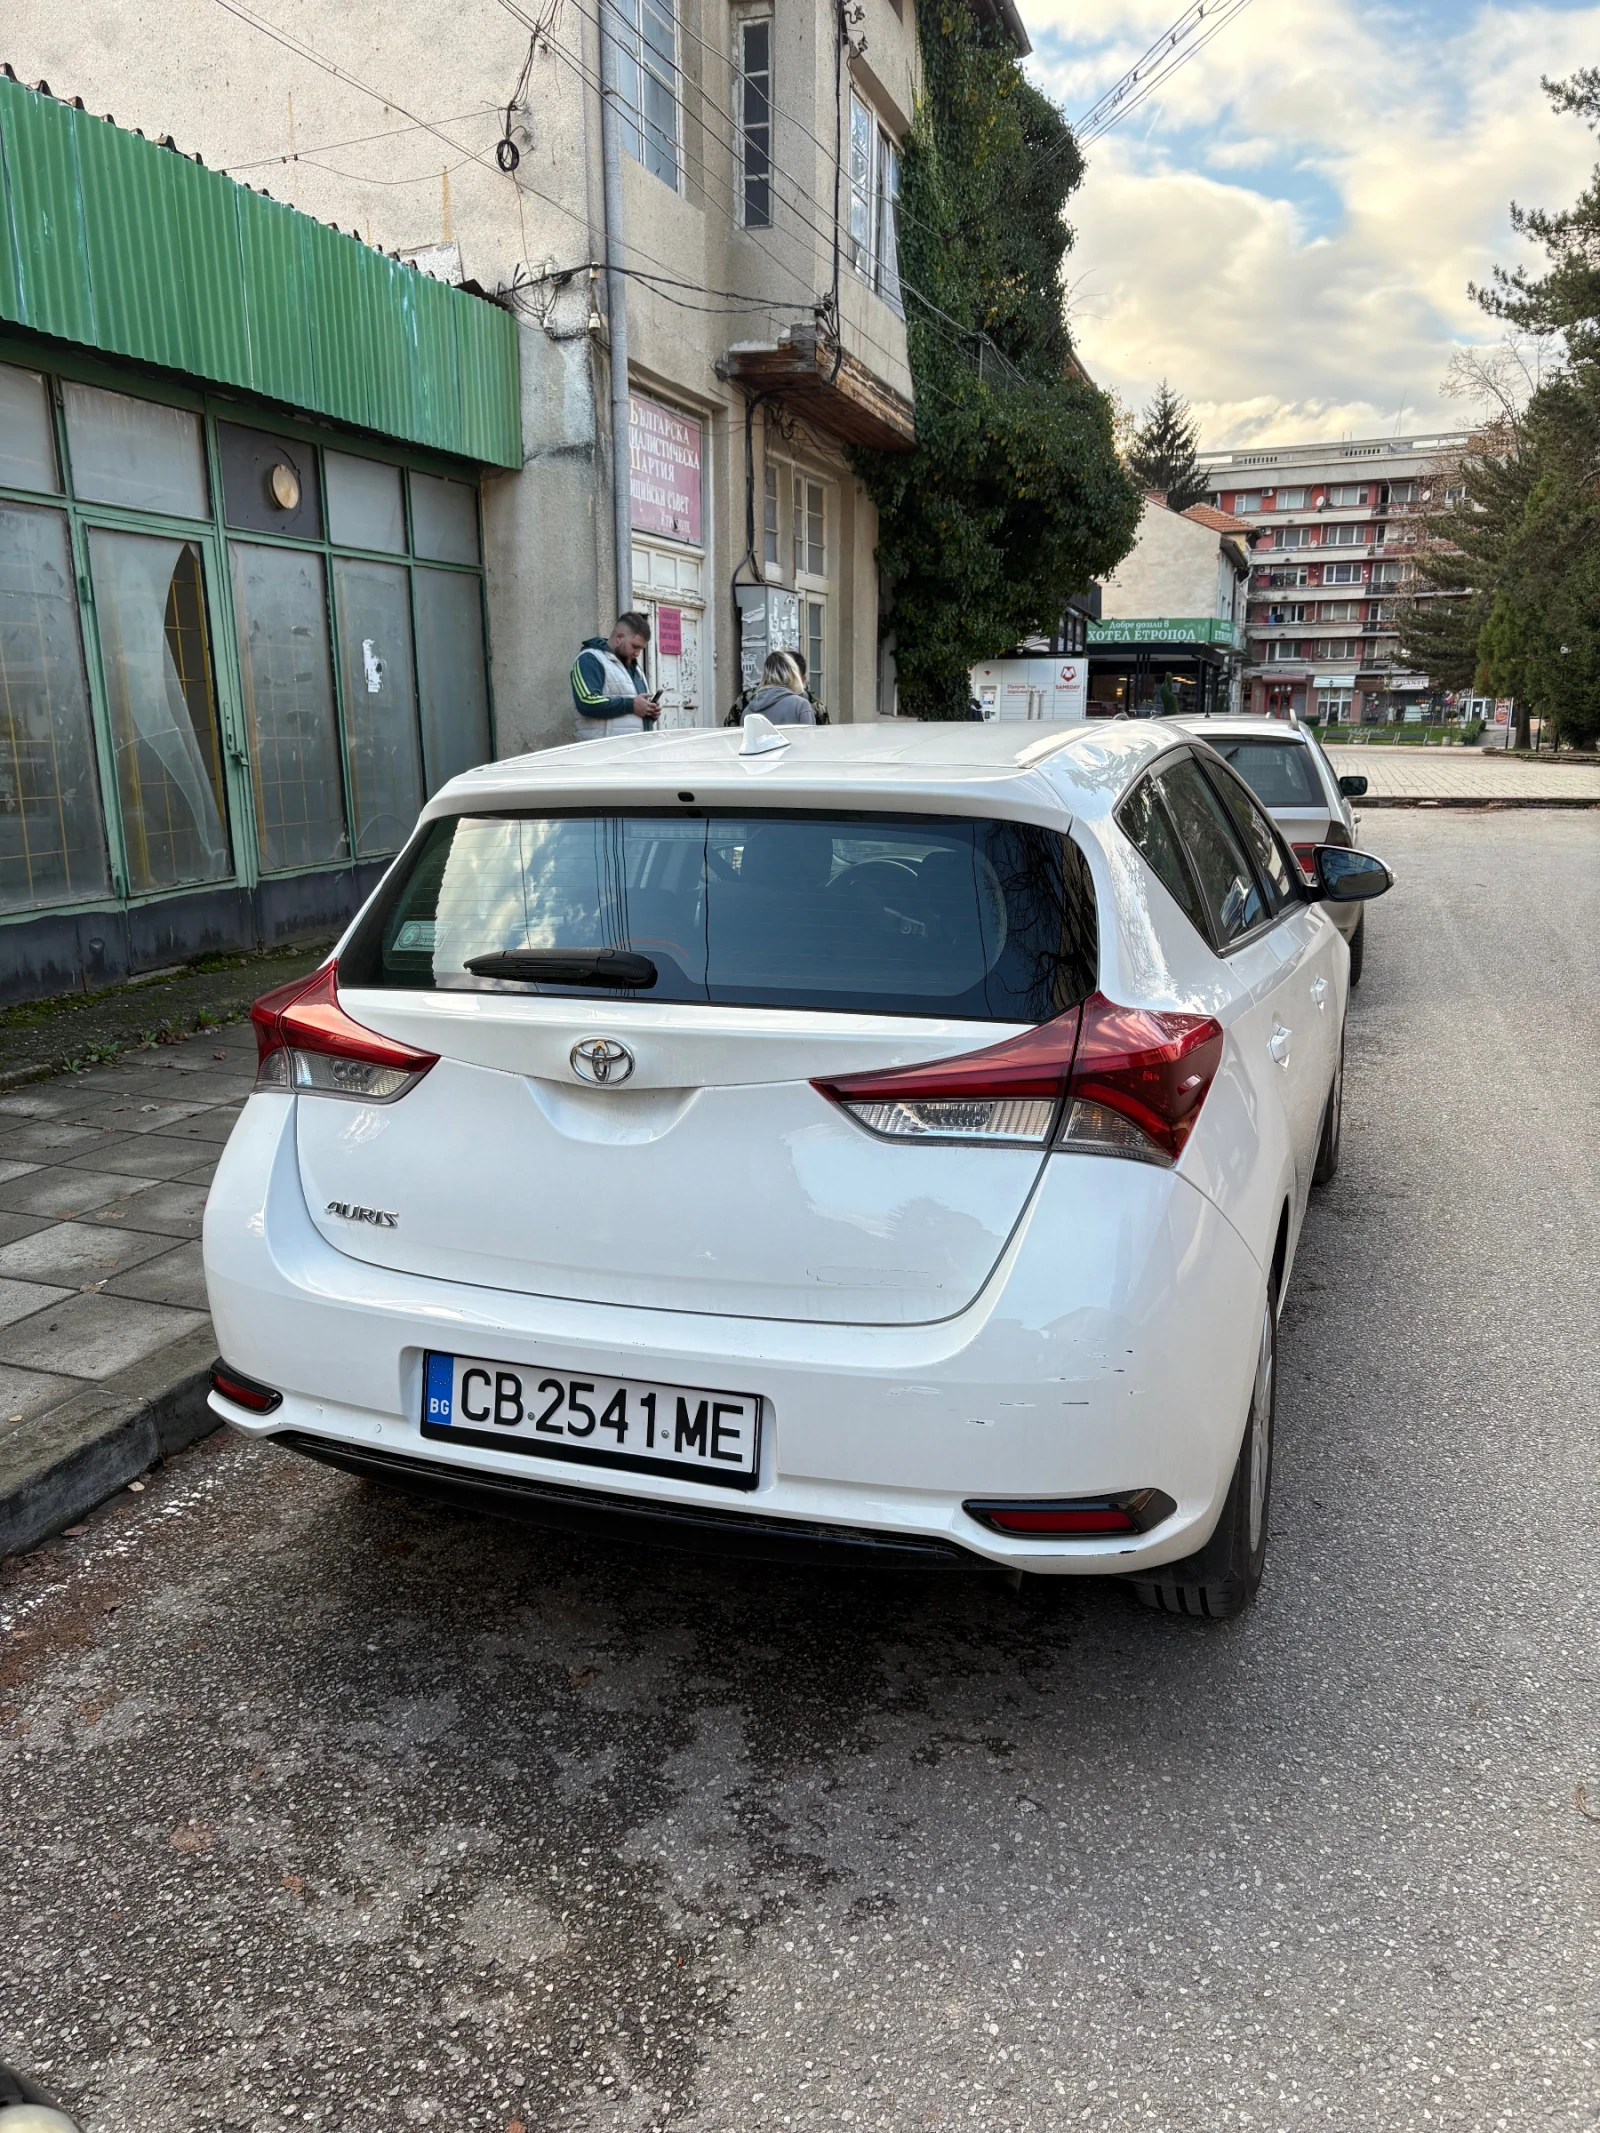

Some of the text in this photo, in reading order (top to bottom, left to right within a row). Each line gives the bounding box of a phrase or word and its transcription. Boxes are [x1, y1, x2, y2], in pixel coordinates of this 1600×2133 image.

[629, 399, 690, 445] БЪЛГАРСКА
[630, 446, 675, 482] ПАРТИЯ
[1087, 630, 1196, 641] ХОТЕЛ ЕТРОПОЛ
[1109, 621, 1134, 630] Добре
[1136, 622, 1162, 630] дошли
[324, 1200, 399, 1229] AURIS
[429, 1398, 450, 1415] BG
[461, 1368, 746, 1463] CB 2541 ME
